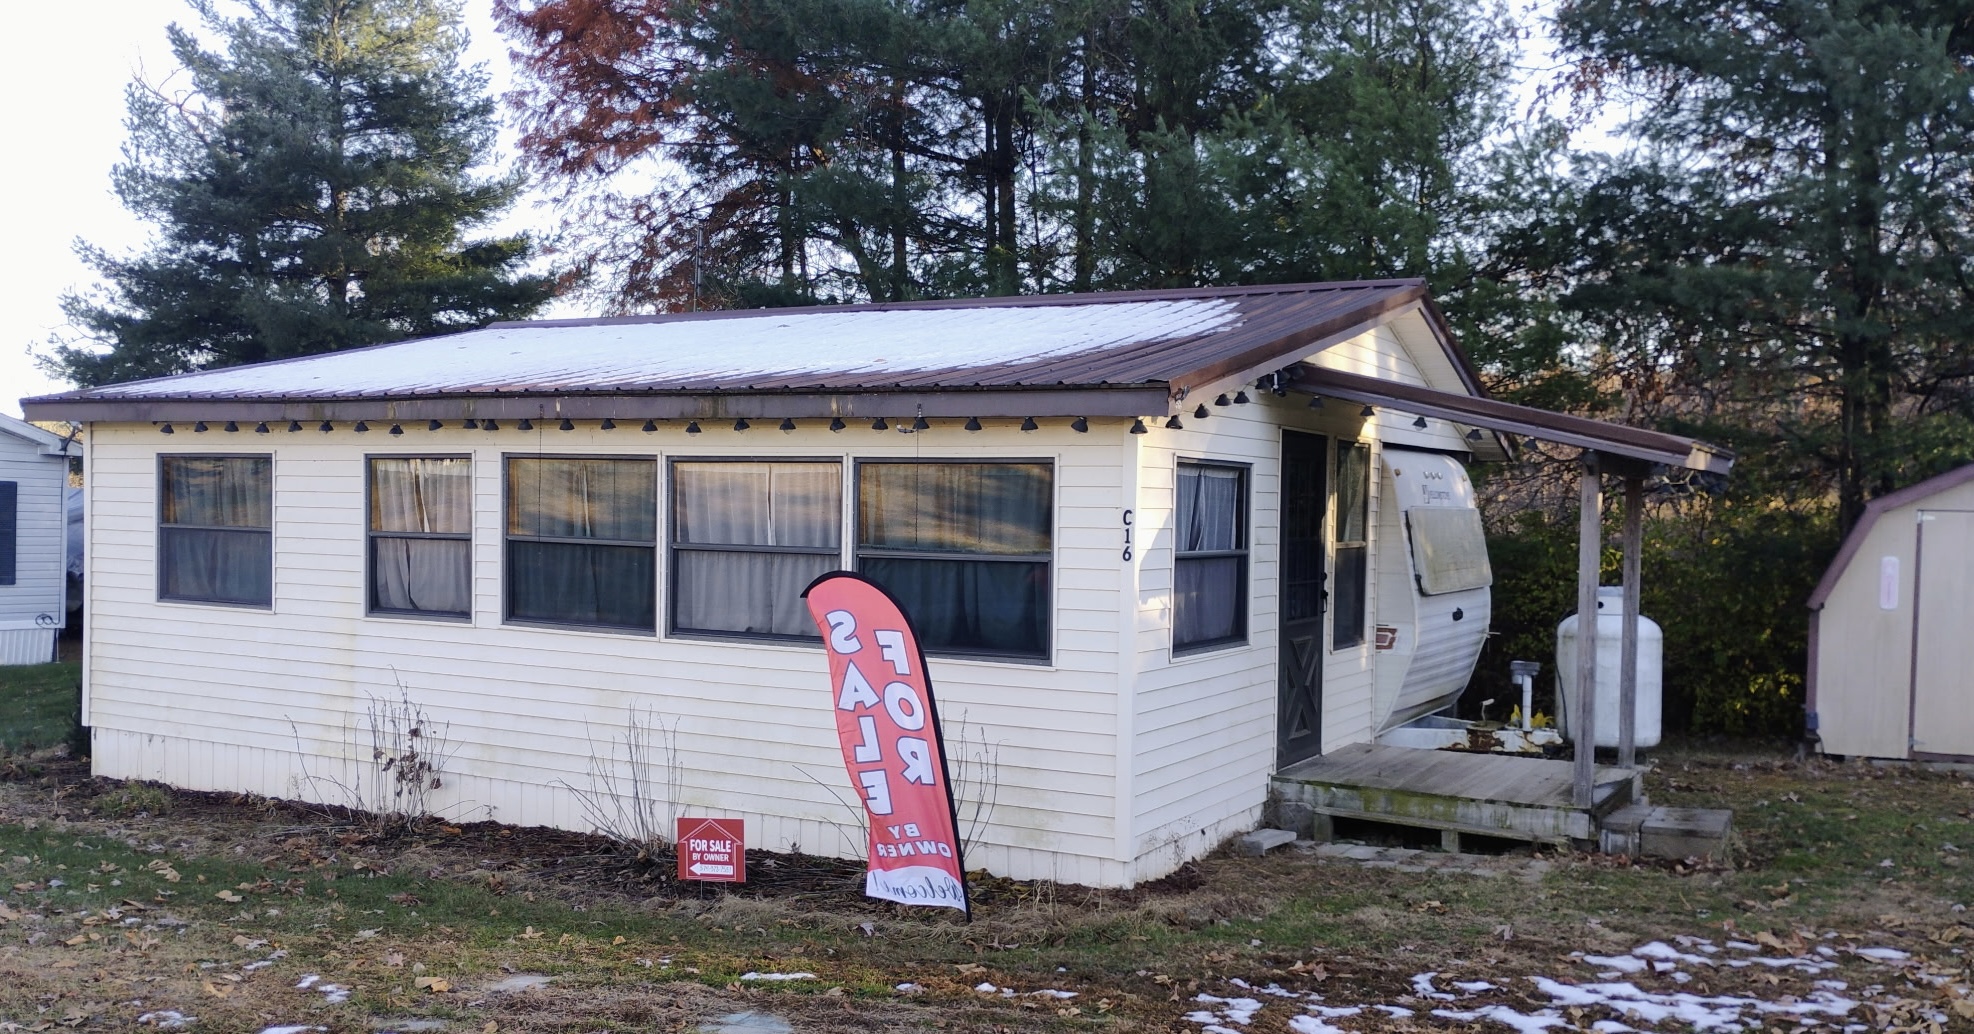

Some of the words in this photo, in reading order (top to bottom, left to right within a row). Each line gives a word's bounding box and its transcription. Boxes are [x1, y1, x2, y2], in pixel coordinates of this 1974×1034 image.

[1122, 509, 1133, 562] C16
[689, 839, 708, 851] FOR
[709, 840, 731, 852] SALE
[703, 853, 729, 861] OWNER
